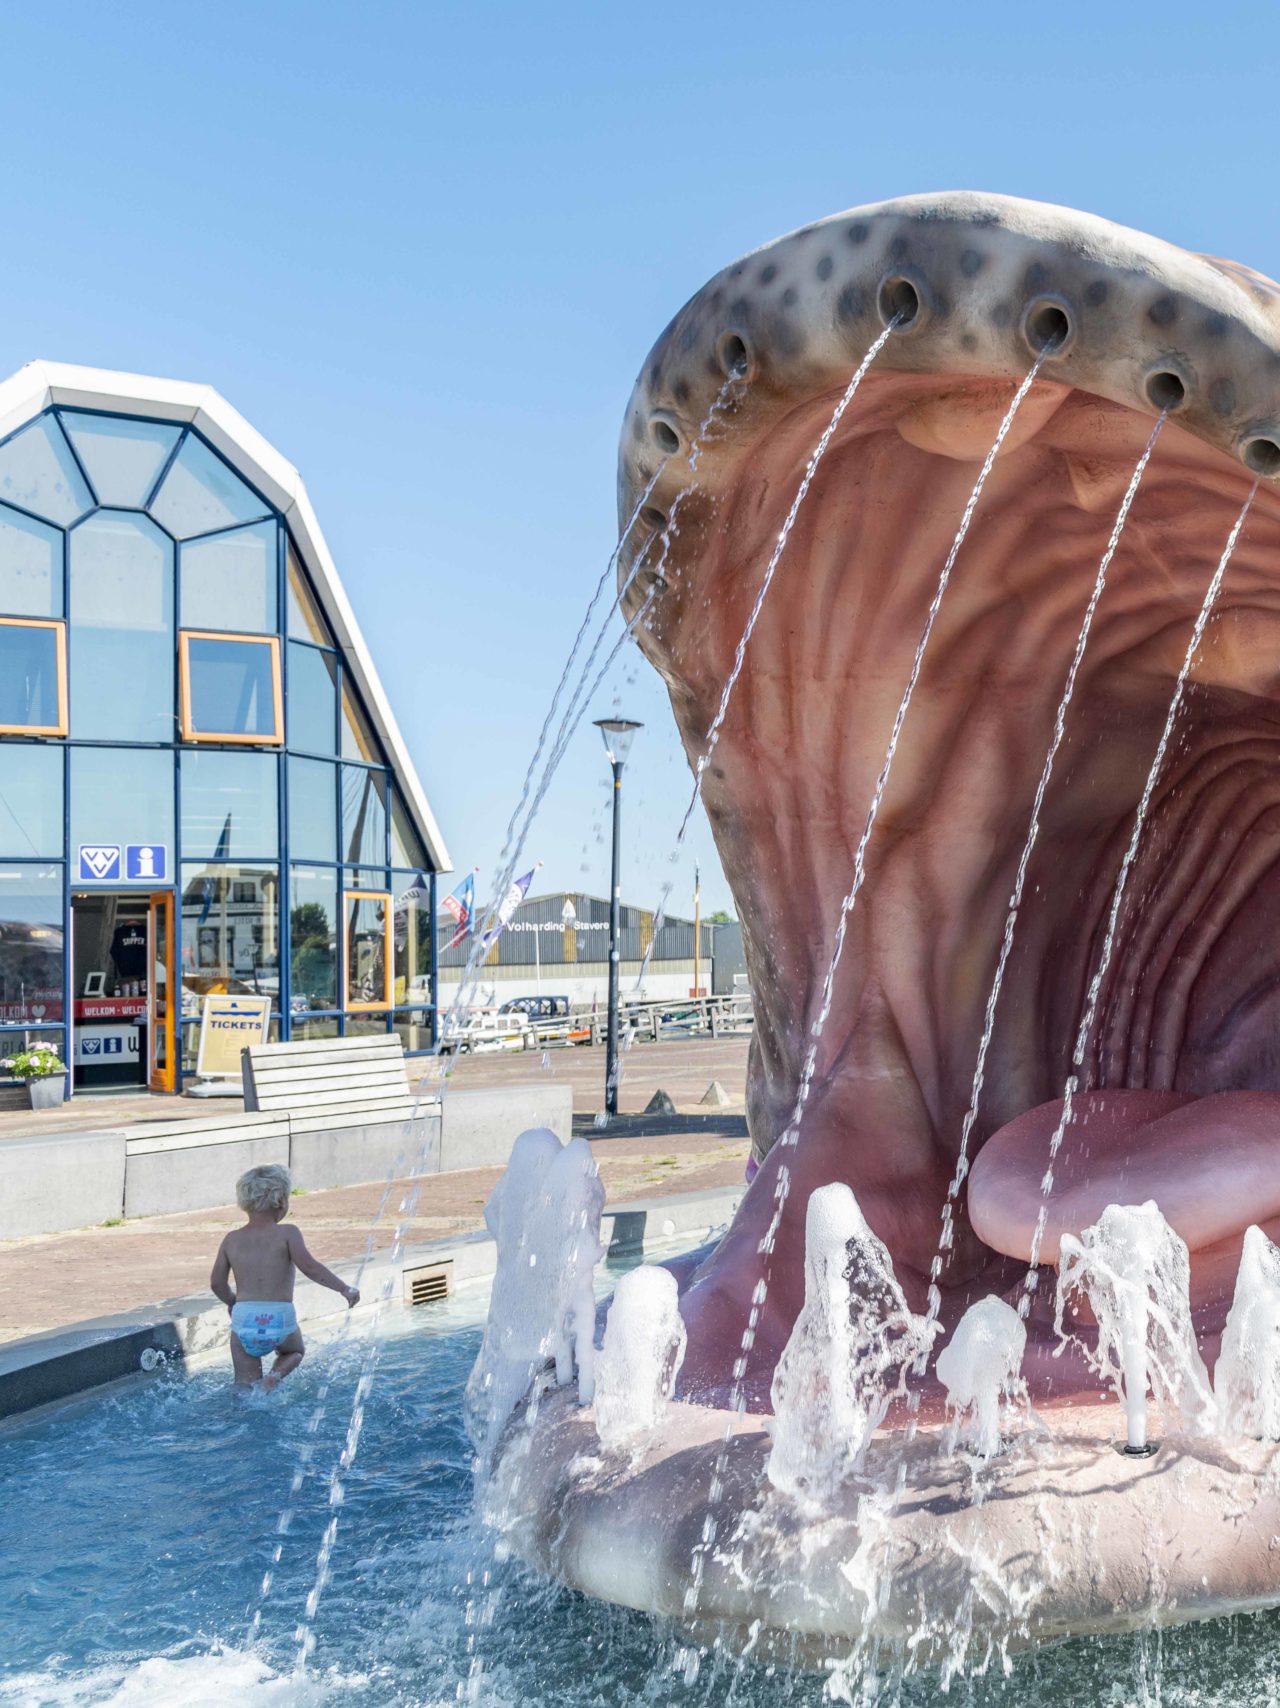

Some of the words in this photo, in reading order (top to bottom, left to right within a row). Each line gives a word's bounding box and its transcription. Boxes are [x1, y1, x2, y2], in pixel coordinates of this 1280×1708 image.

[507, 921, 565, 932] Volharding
[574, 921, 609, 930] Stavere
[84, 1006, 115, 1016] WELKOM
[122, 1005, 147, 1015] WELCO
[211, 1021, 262, 1029] TICKETS
